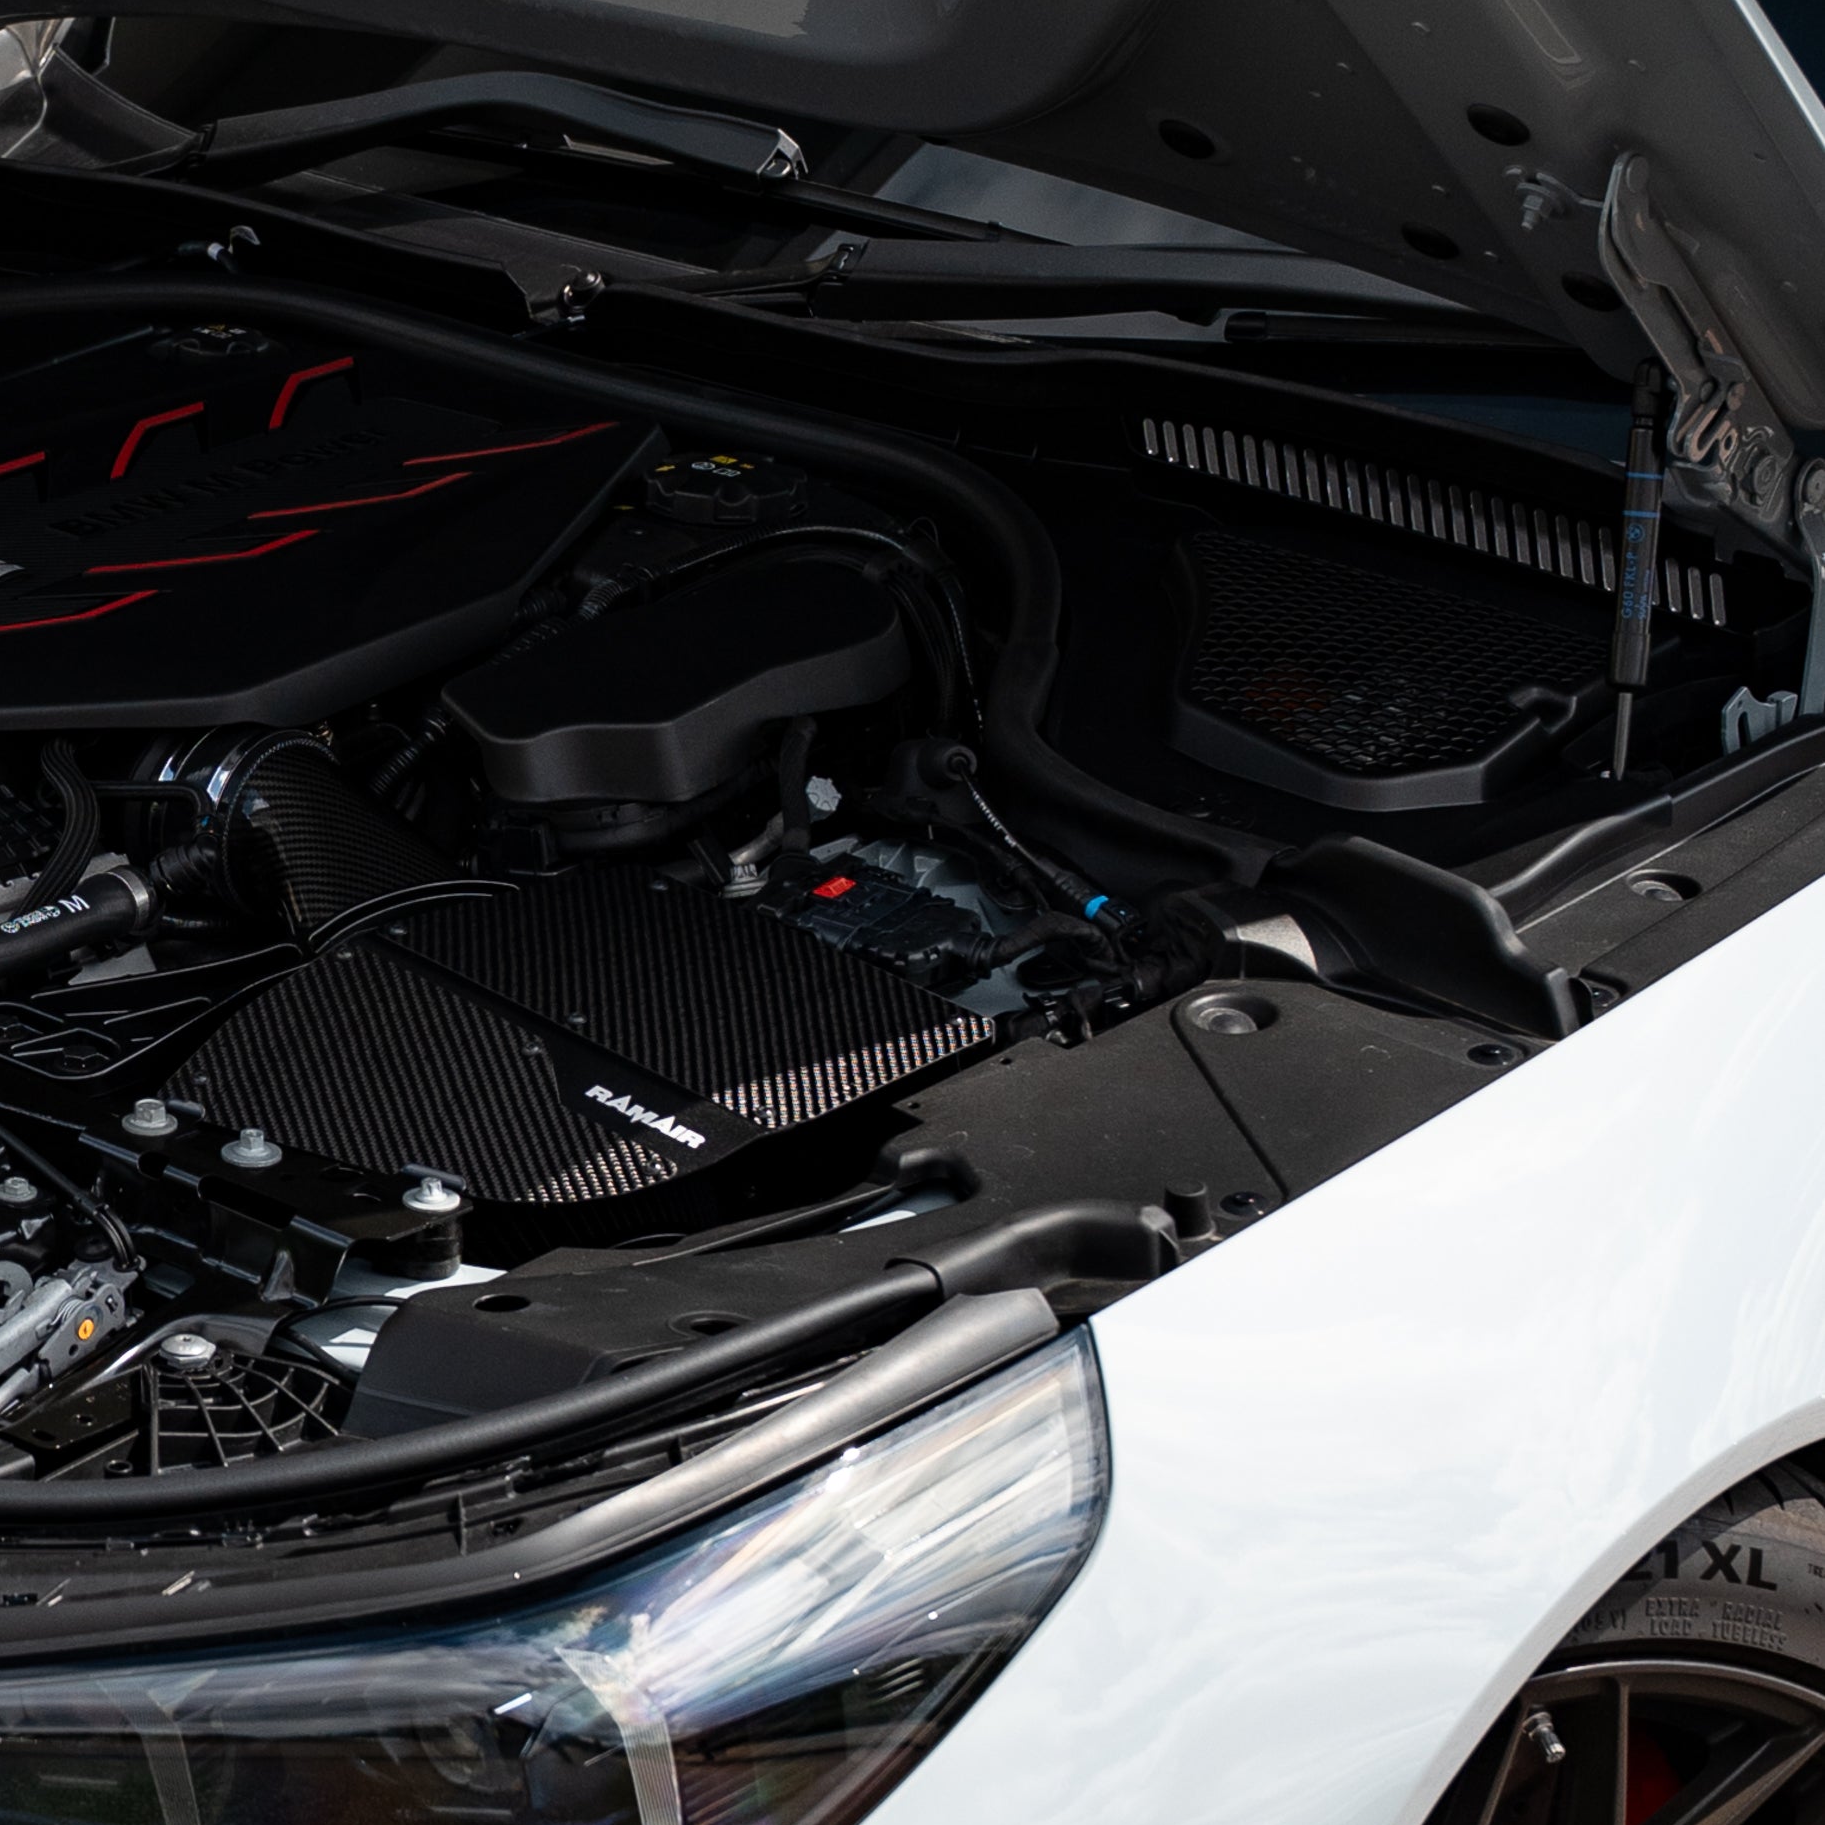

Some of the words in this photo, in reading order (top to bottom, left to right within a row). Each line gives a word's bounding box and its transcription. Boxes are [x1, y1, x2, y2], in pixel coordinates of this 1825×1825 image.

[584, 1084, 706, 1149] RAMAIR
[1698, 1538, 1779, 1591] XL
[1645, 1597, 1700, 1617] EXTRA
